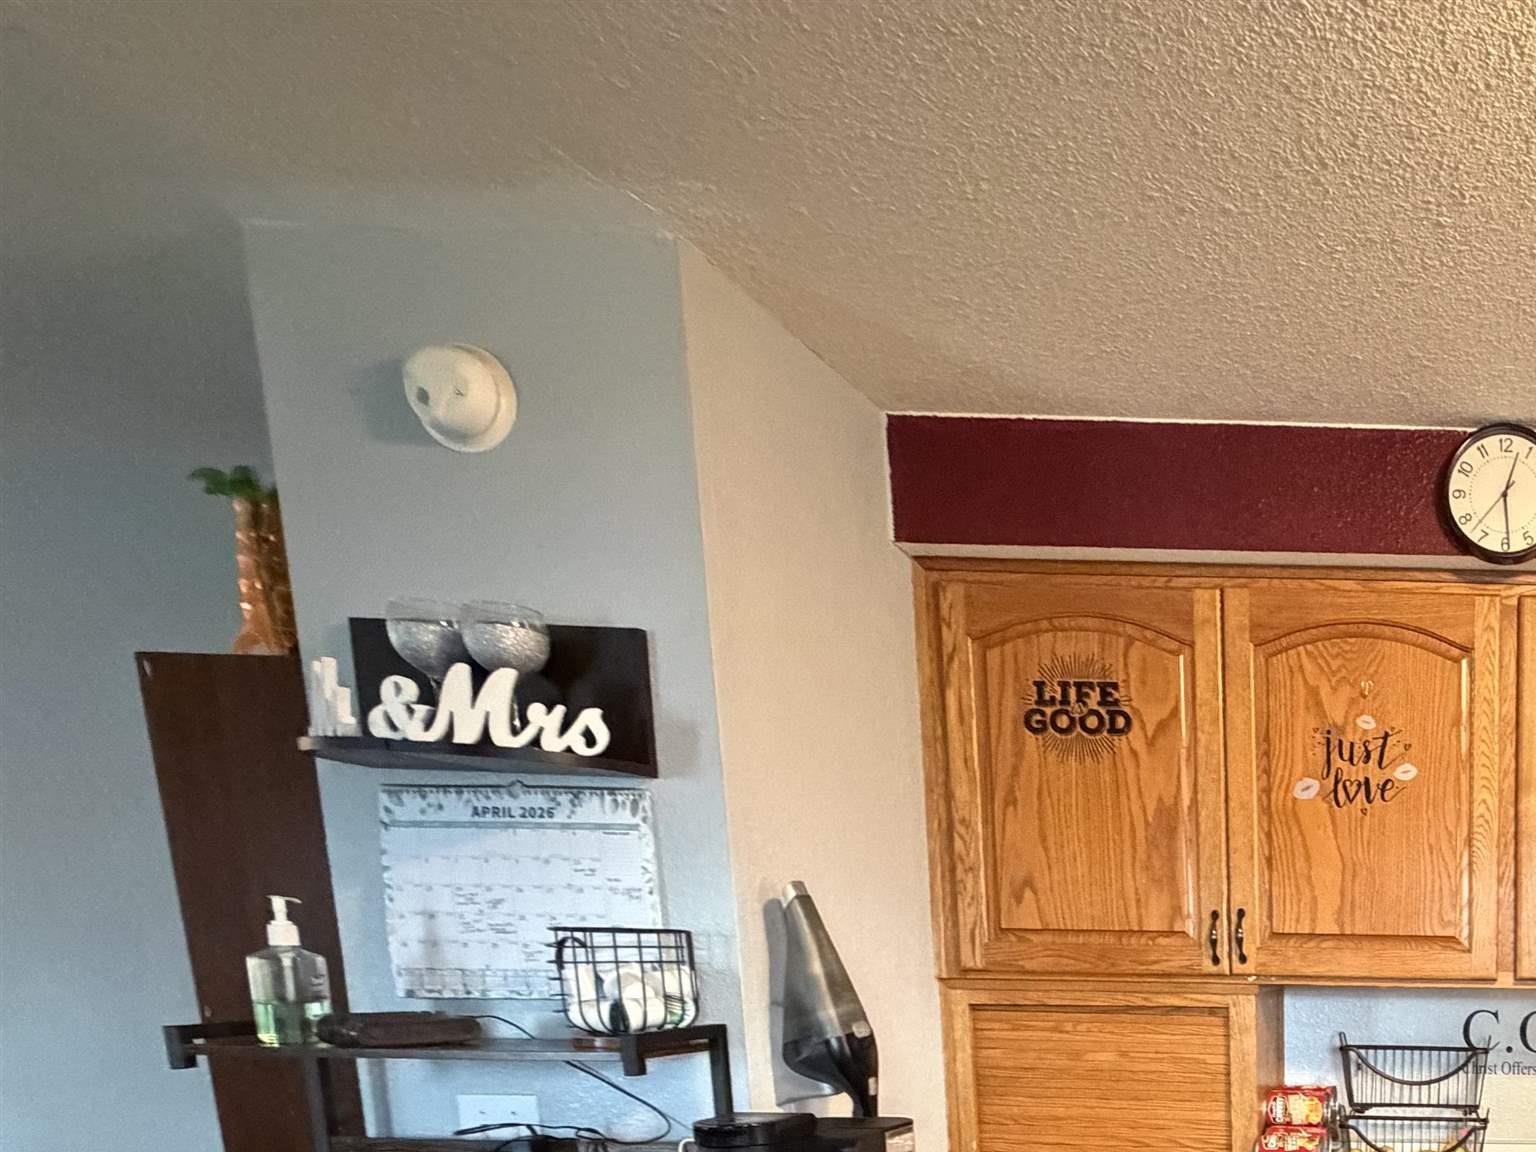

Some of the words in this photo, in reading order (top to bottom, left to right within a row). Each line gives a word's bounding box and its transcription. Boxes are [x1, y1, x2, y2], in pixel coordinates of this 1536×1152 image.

[1476, 443, 1489, 459] 11
[1499, 438, 1513, 453] 12
[1524, 446, 1534, 459] 1
[1457, 461, 1474, 478] 10
[1452, 489, 1467, 500] 9
[1458, 513, 1473, 526] 8
[1477, 529, 1489, 543] 7
[1522, 530, 1535, 546] 5
[1500, 537, 1510, 551] 6
[1033, 680, 1121, 707] LIFE
[368, 674, 437, 740] &
[408, 662, 611, 757] Mrs
[1023, 708, 1133, 736] GOOD
[1321, 729, 1406, 780] just
[471, 806, 516, 819] APRIL
[1500, 1061, 1536, 1076] Offers
